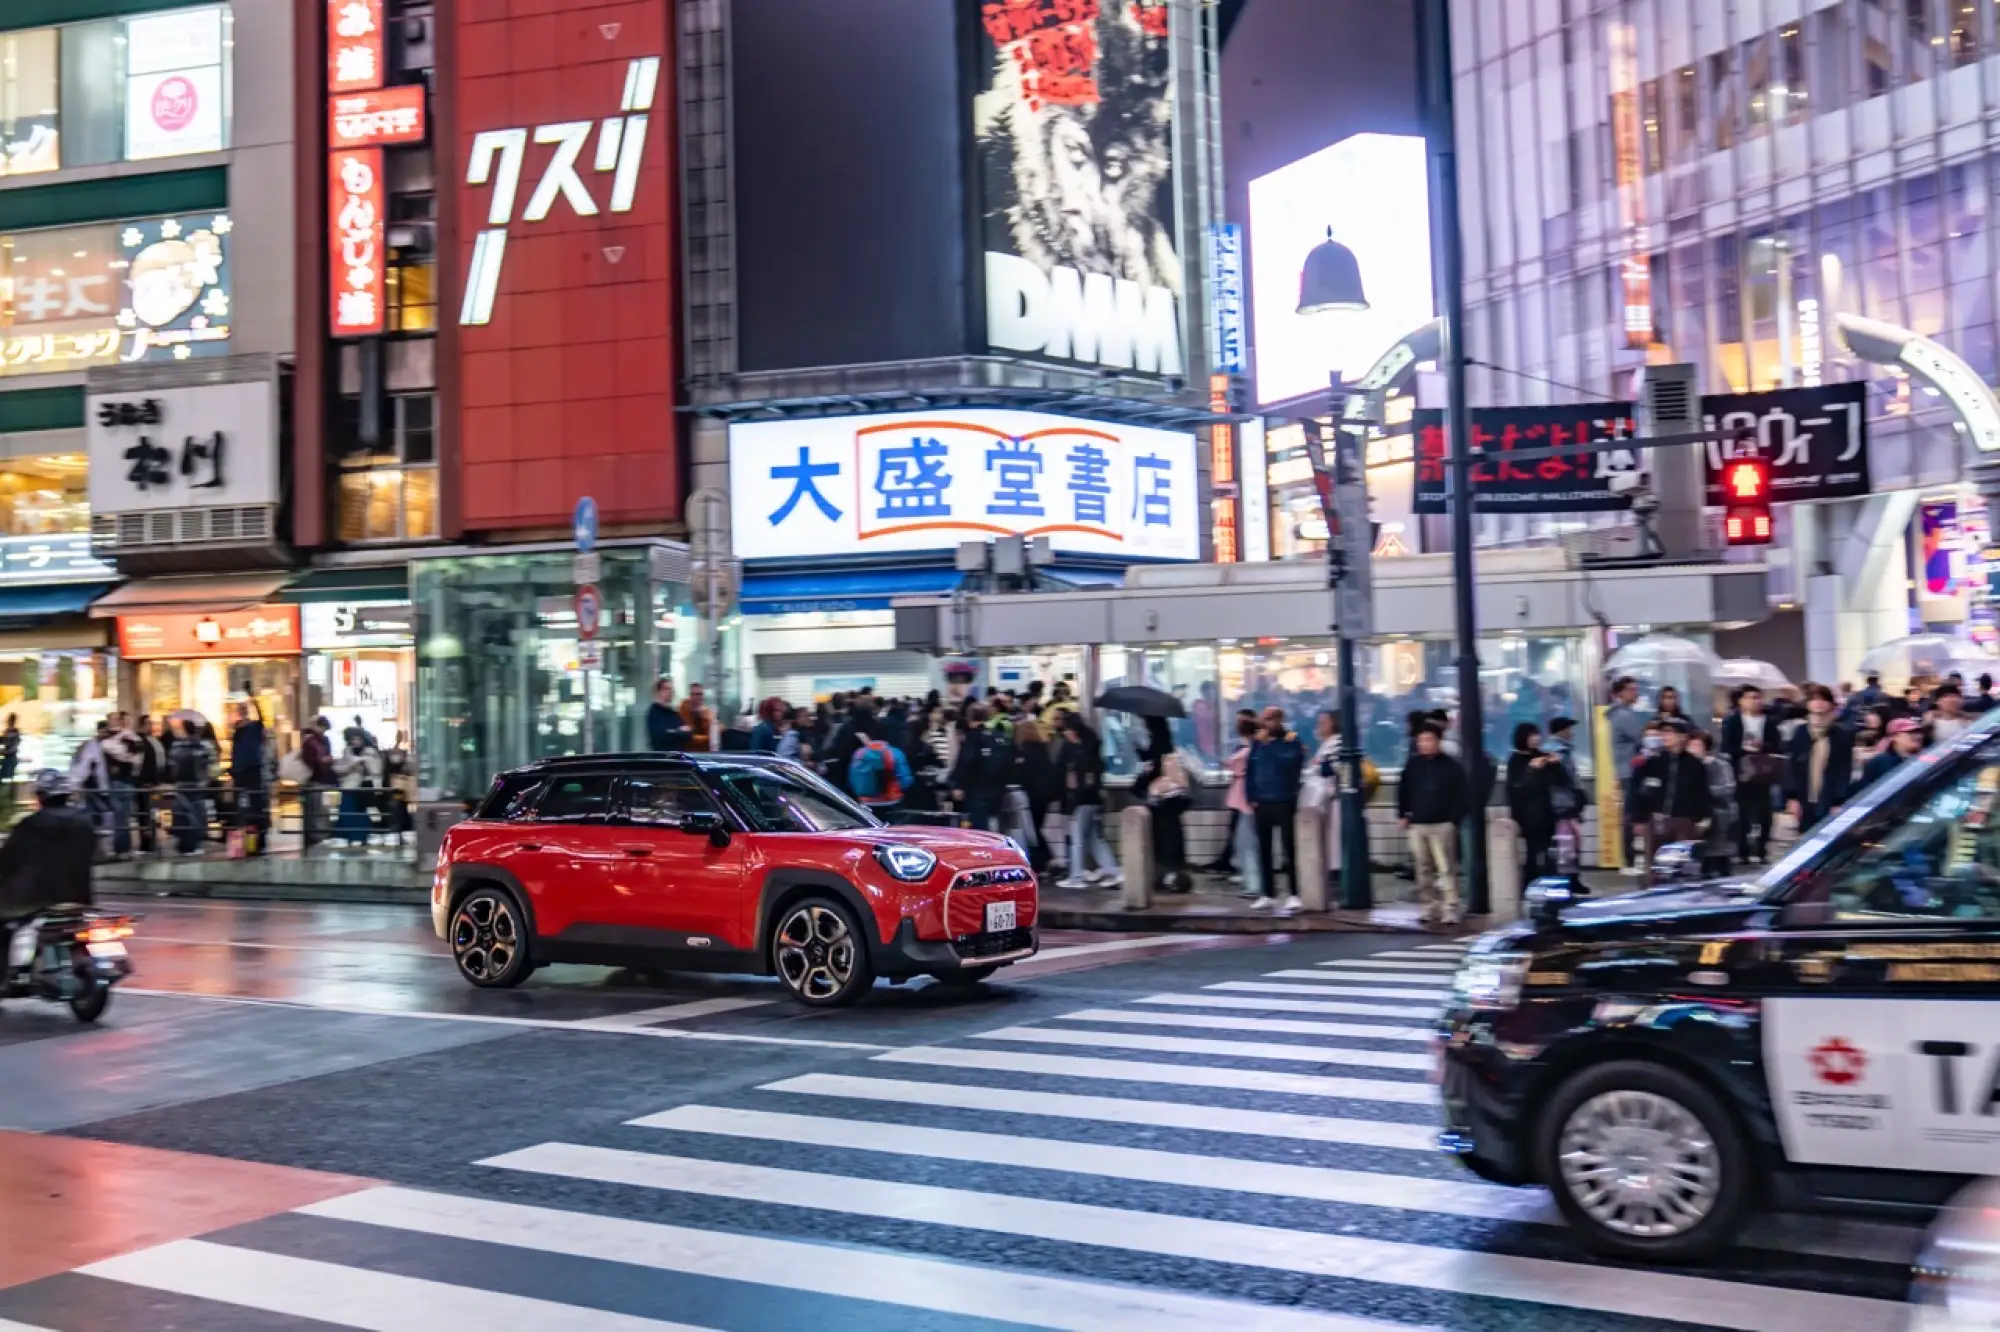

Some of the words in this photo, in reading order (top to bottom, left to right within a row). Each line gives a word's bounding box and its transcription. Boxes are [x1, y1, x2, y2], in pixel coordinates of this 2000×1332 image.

[767, 436, 1173, 529] 大盛堂書店
